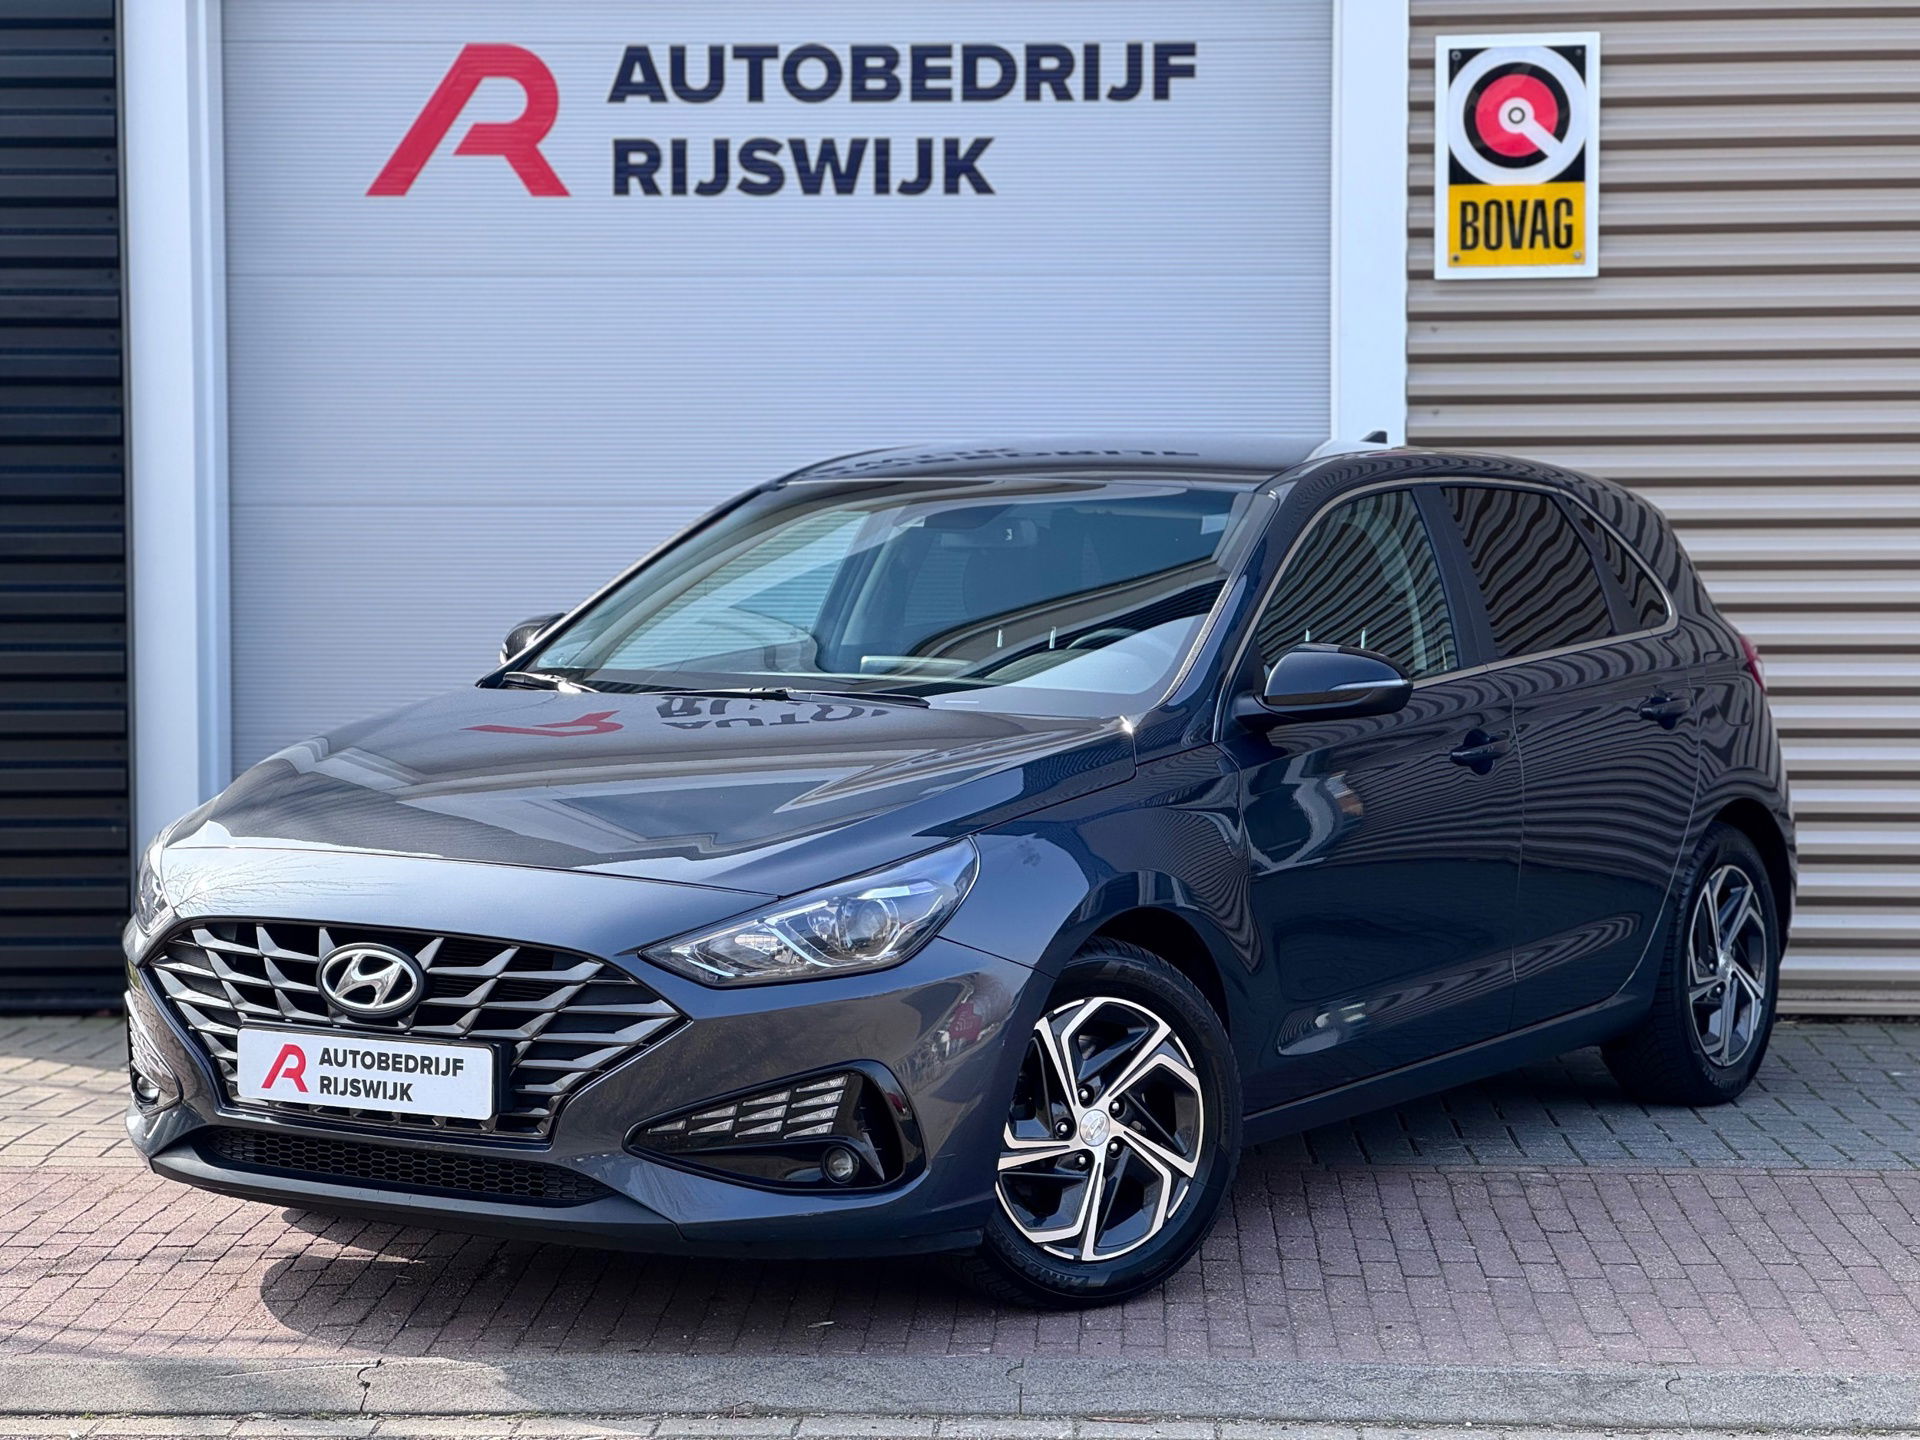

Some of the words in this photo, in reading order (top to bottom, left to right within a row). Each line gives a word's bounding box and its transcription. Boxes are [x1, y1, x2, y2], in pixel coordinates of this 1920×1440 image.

[608, 43, 1197, 103] AUTOBEDRIJF
[613, 137, 995, 196] RIJSWIJK
[1460, 197, 1574, 251] BOVAG
[319, 1047, 464, 1077] AUTOBEDRIJF
[319, 1076, 413, 1102] RIJSWIJK
